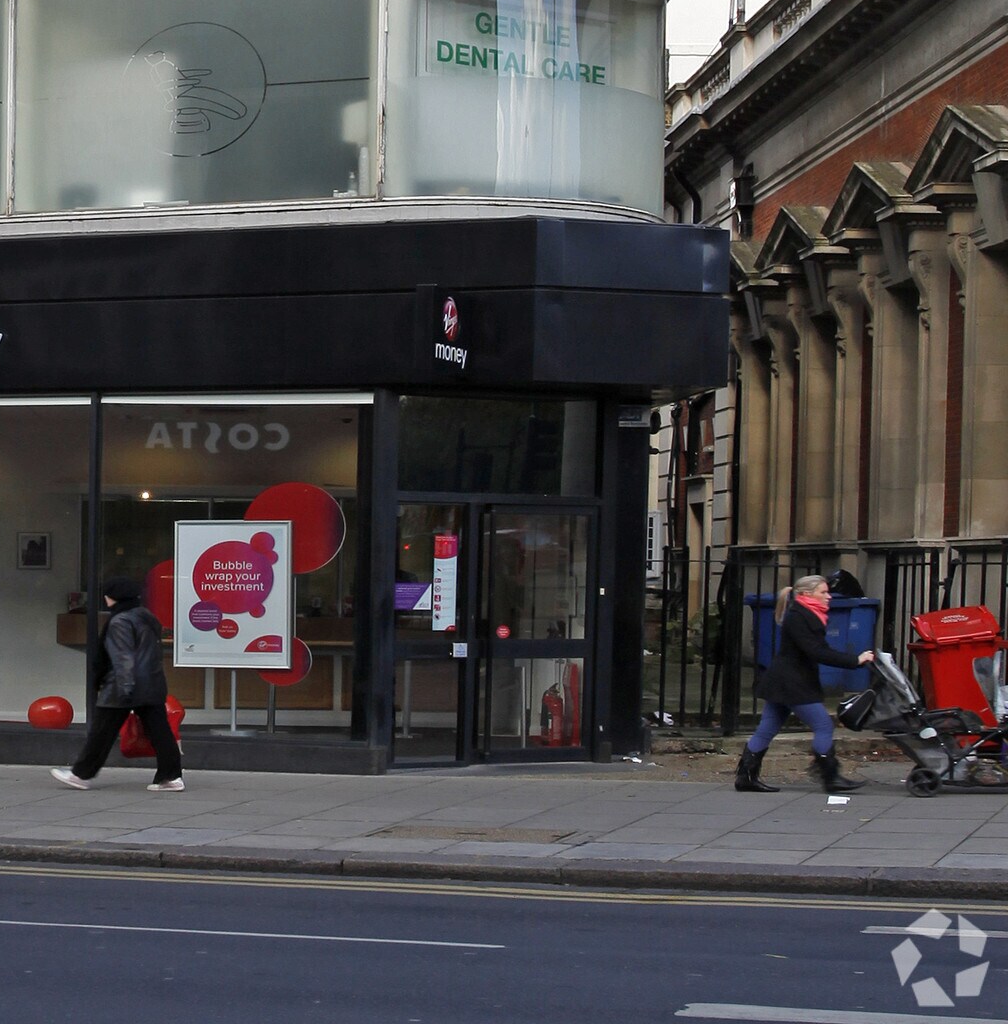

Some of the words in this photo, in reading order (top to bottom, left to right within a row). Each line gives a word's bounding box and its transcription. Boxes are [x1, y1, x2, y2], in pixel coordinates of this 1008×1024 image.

[475, 12, 570, 48] GENTLE
[437, 40, 534, 75] DENTAL
[542, 57, 606, 85] CARE
[435, 343, 467, 369] money
[213, 560, 253, 570] Bubble
[201, 581, 265, 591] investment
[205, 572, 233, 582] wrap
[235, 572, 261, 582] your
